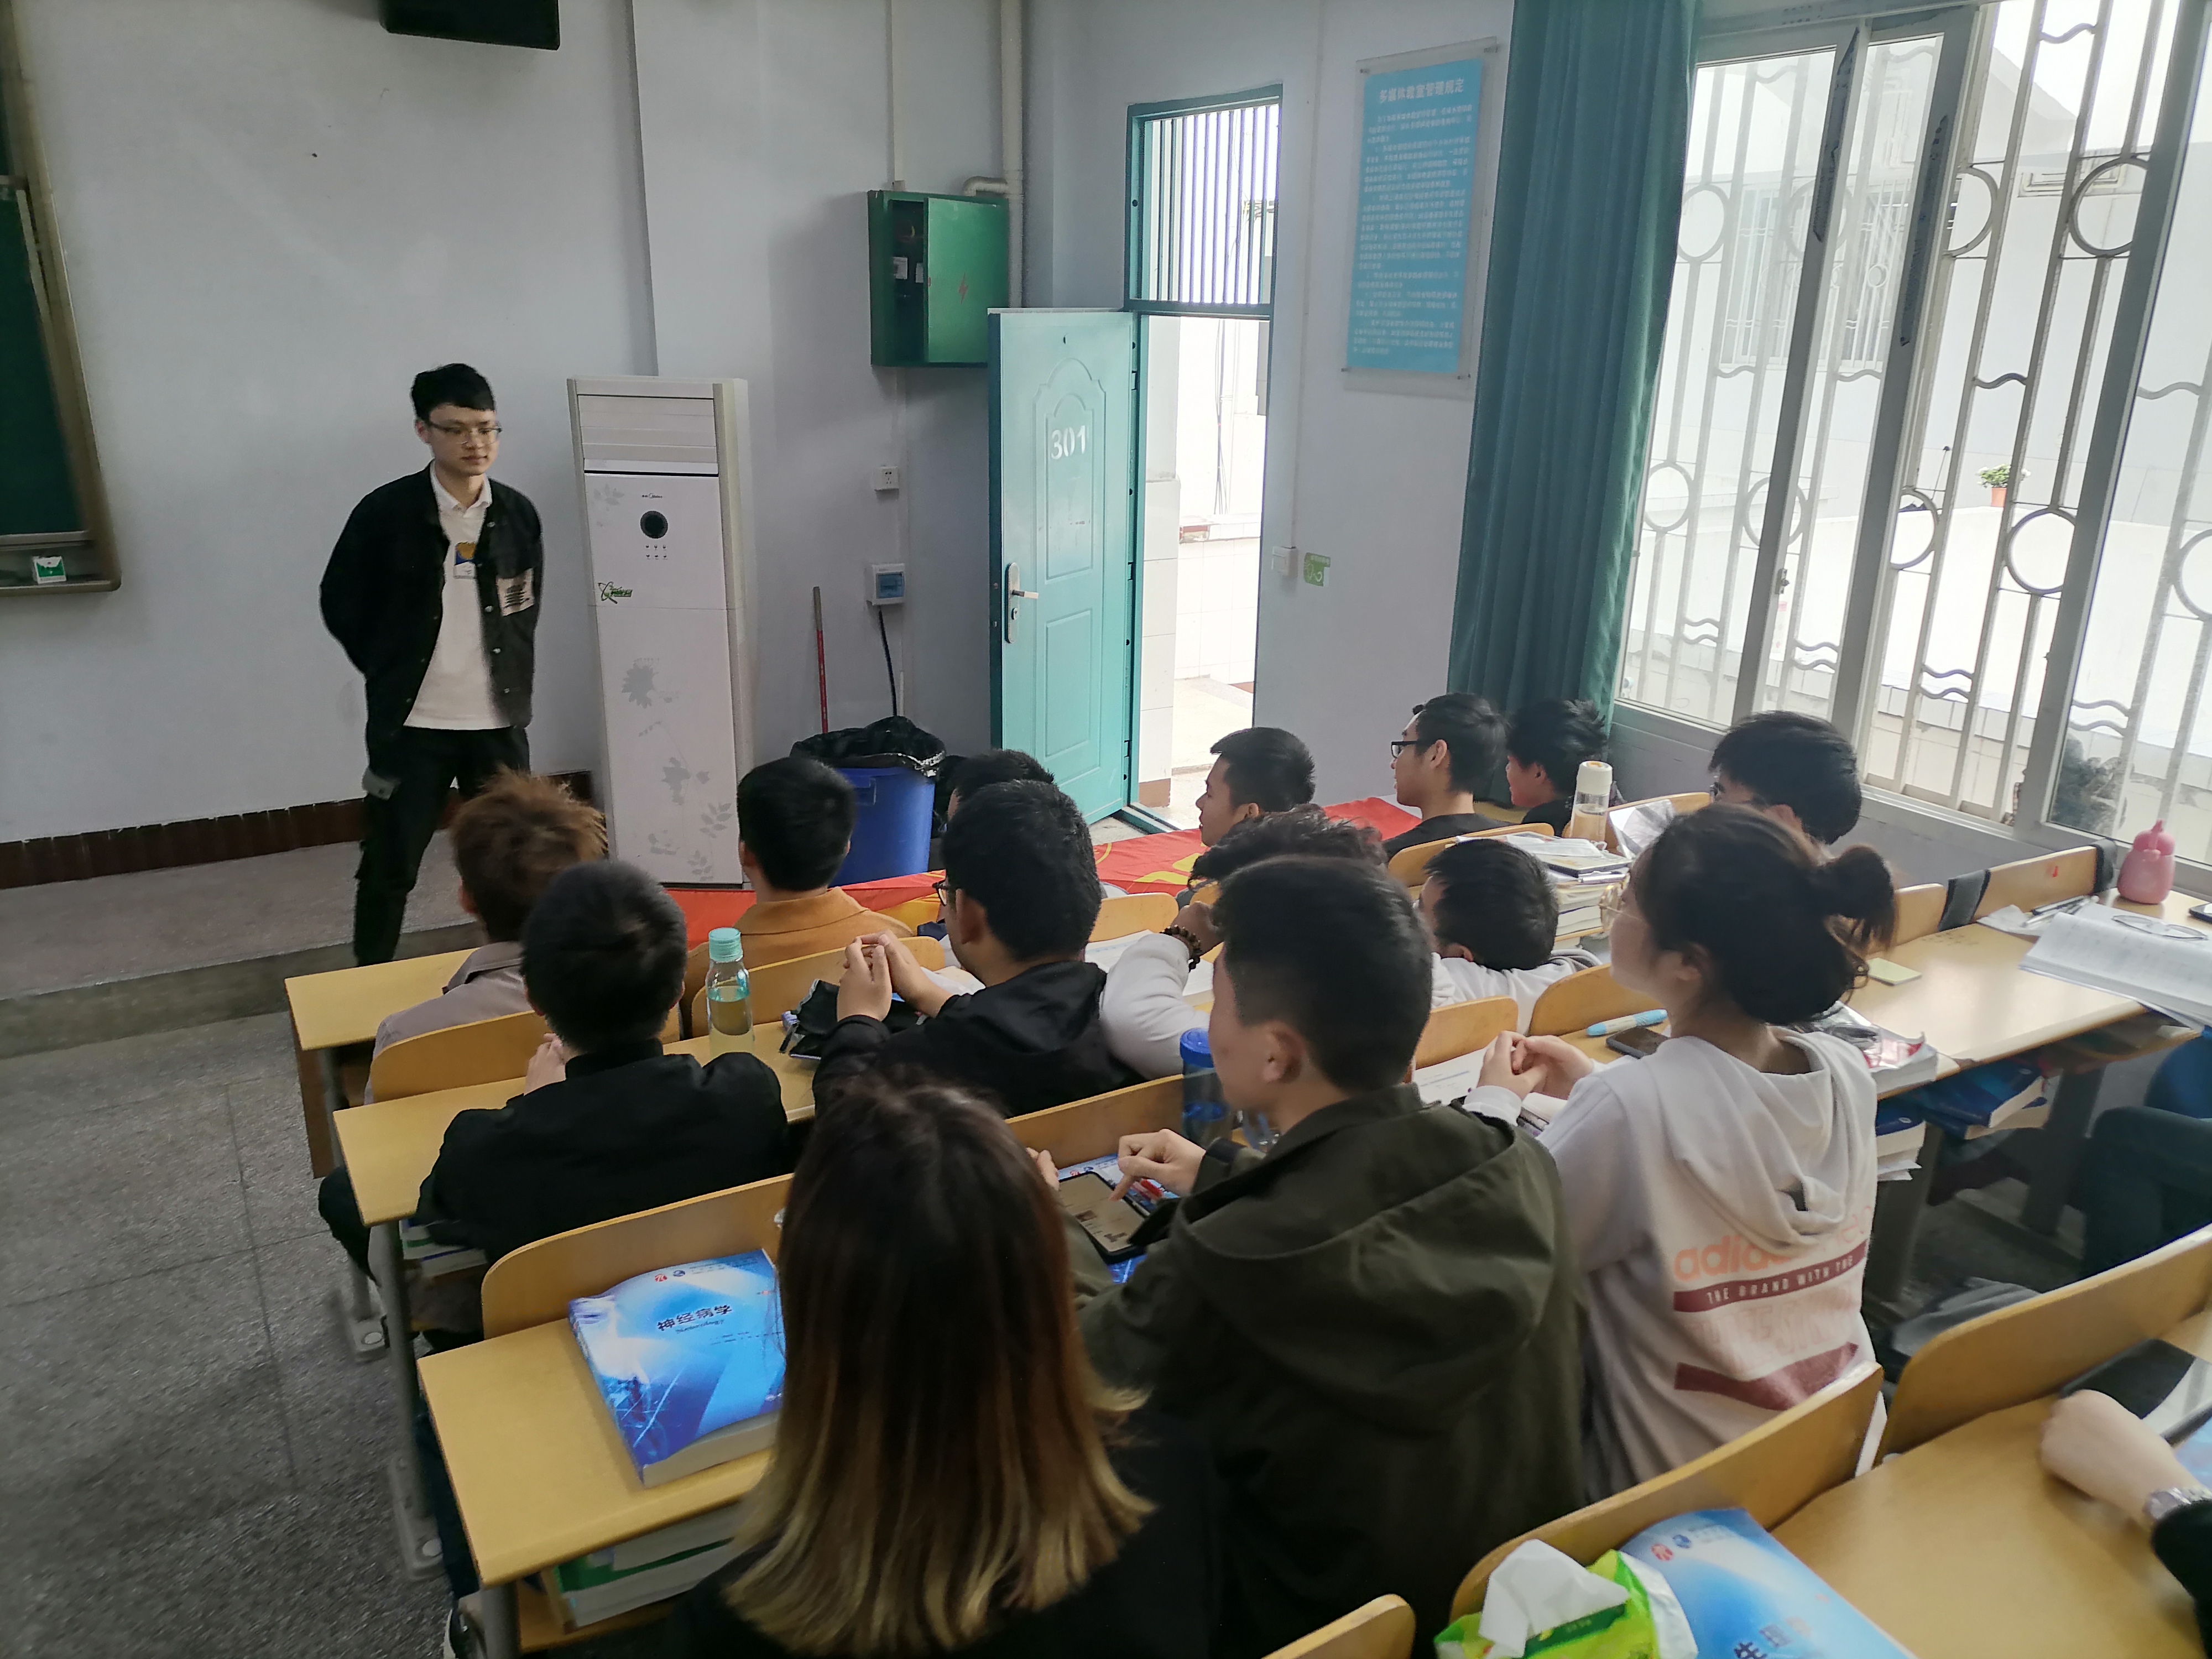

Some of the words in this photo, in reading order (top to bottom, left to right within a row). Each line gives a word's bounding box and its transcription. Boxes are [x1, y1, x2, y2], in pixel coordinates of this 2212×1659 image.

[1051, 425, 1086, 460] 301
[1674, 1235, 1793, 1281] adid
[1707, 1287, 1729, 1304] THE
[1739, 1277, 1790, 1297] BRAND
[1797, 1266, 1829, 1285] WITH
[657, 1303, 733, 1332] 神经病学
